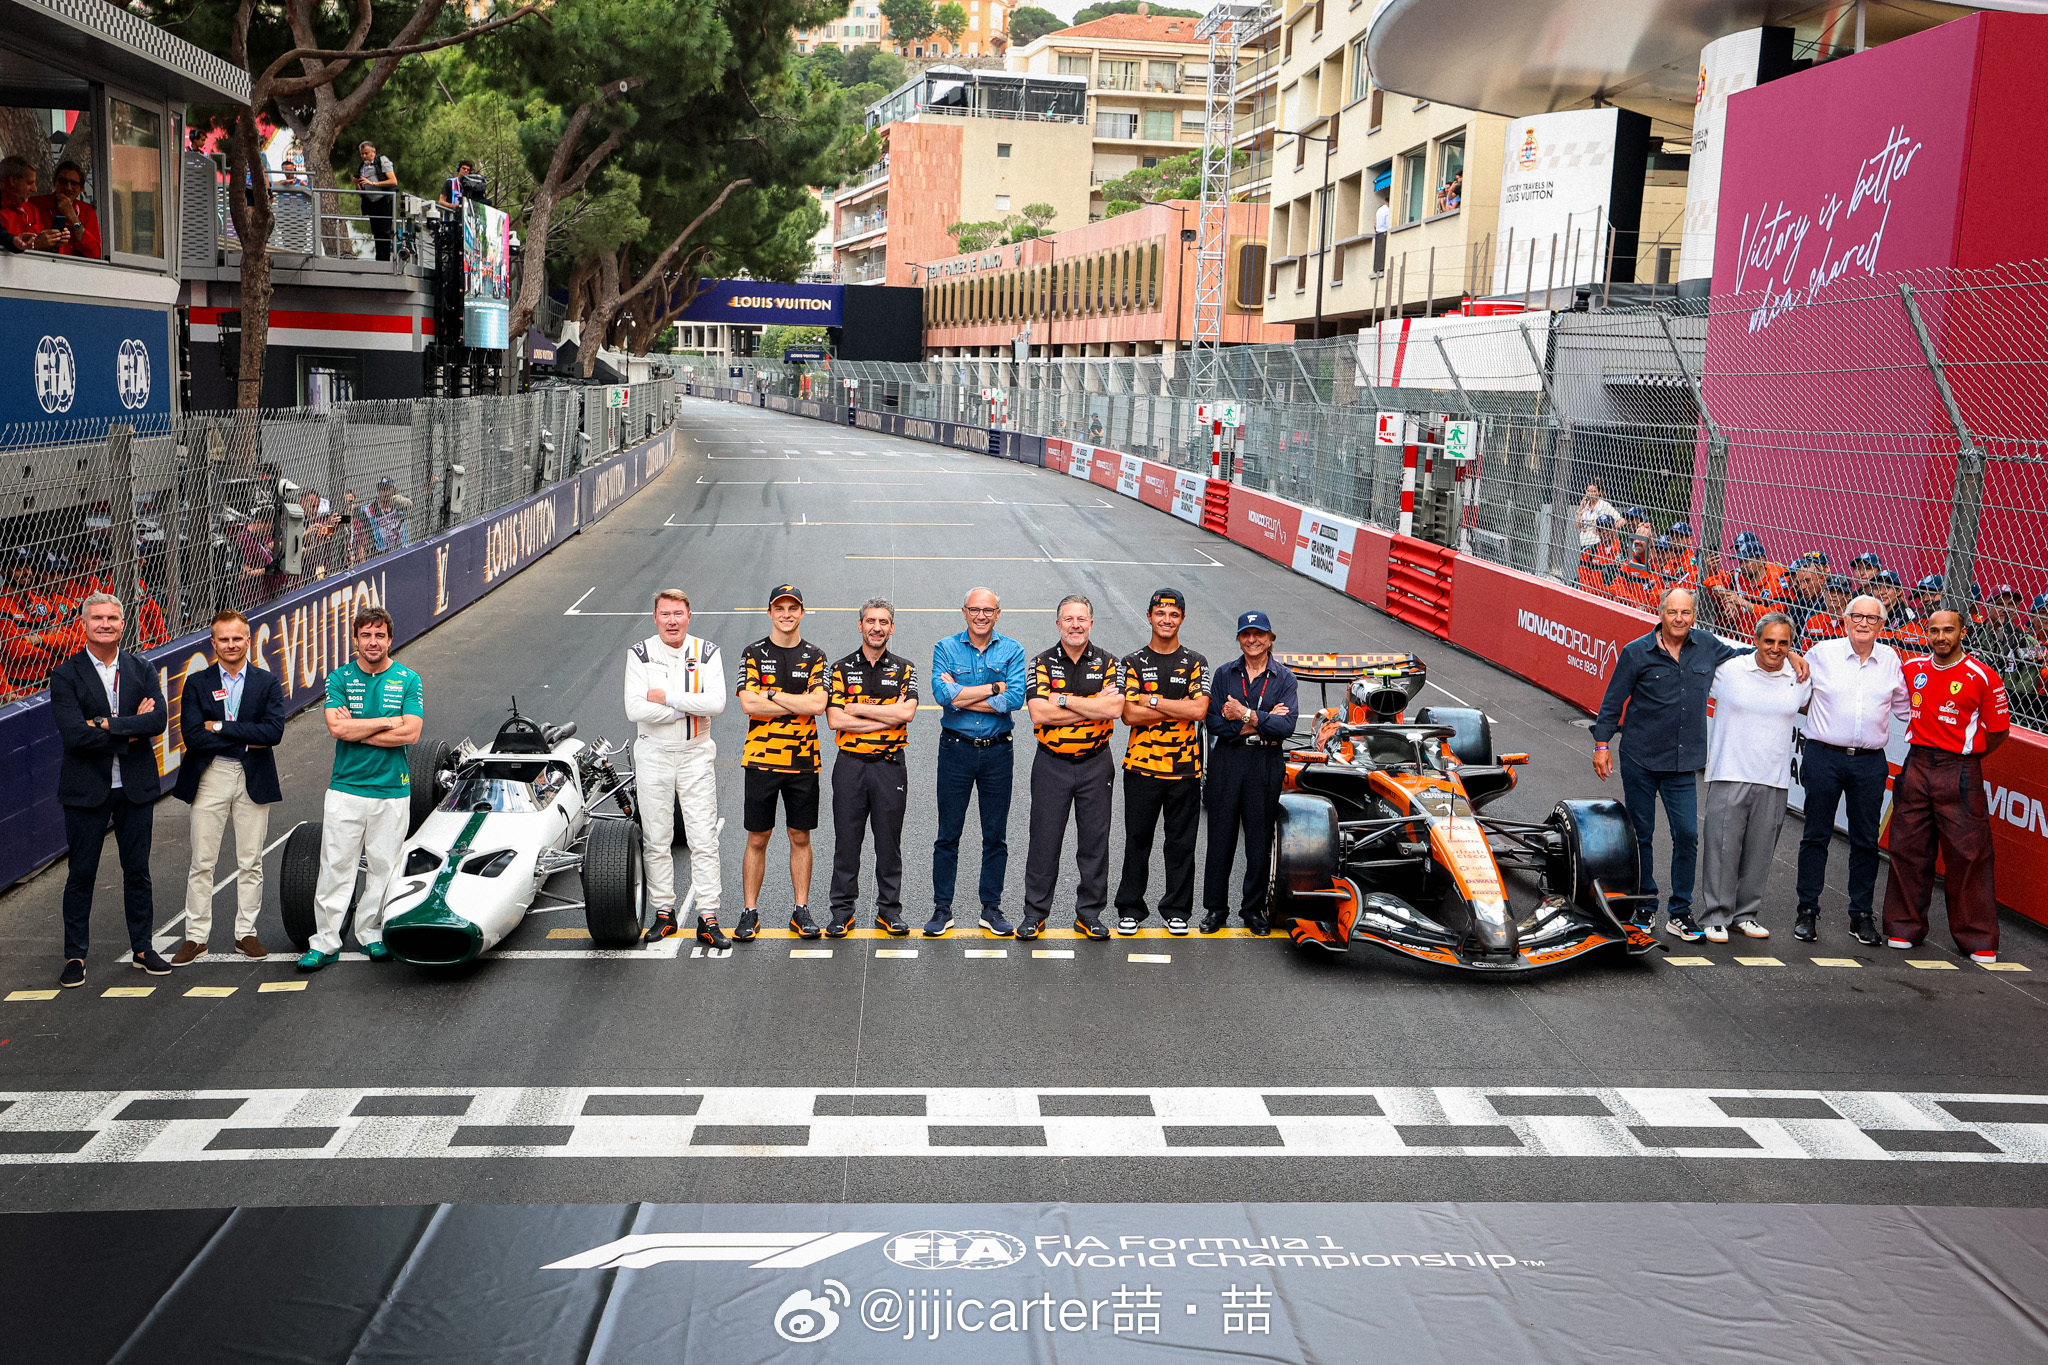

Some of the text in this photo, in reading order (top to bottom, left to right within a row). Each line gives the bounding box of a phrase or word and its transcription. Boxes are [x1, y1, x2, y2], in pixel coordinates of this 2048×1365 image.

[1506, 189, 1553, 203] LOUIS VUITTON
[1523, 182, 1544, 190] TRAVELS
[1735, 124, 1922, 296] Victory is better
[1807, 200, 1891, 308] shared
[735, 296, 832, 311] LOUIS VUITTON
[953, 425, 990, 451] LOUIS VUITTON
[485, 494, 556, 583] LOUIS VUITTON
[1311, 540, 1335, 560] GRAND PRIX
[1567, 654, 1598, 676] SINCE 1929
[400, 773, 409, 785] 14
[1555, 806, 1571, 831] ZERO
[1034, 1235, 1110, 1251] FIA
[1120, 1235, 1310, 1251] Formula
[1315, 1235, 1344, 1251] 1
[1037, 1251, 1176, 1268] World
